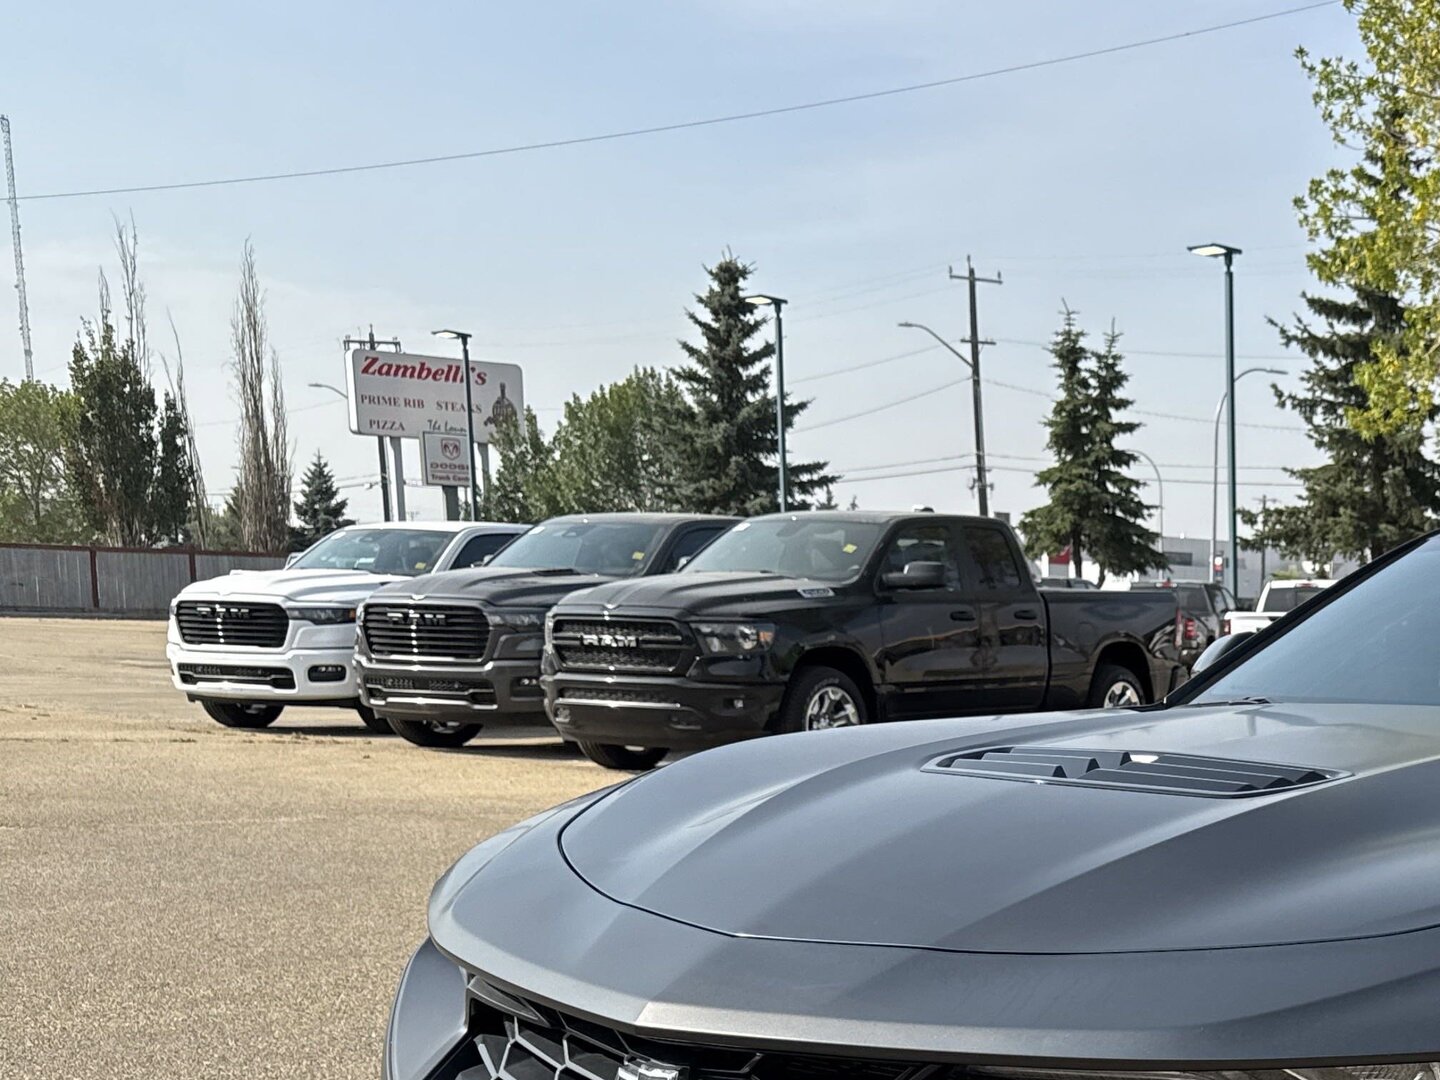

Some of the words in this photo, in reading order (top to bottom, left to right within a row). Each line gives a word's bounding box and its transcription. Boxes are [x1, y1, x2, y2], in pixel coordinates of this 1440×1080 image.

[360, 394, 401, 407] PRIME
[403, 397, 425, 409] RIB
[436, 400, 482, 414] STEAS
[369, 419, 405, 432] PIZZA
[582, 634, 637, 648] RAM
